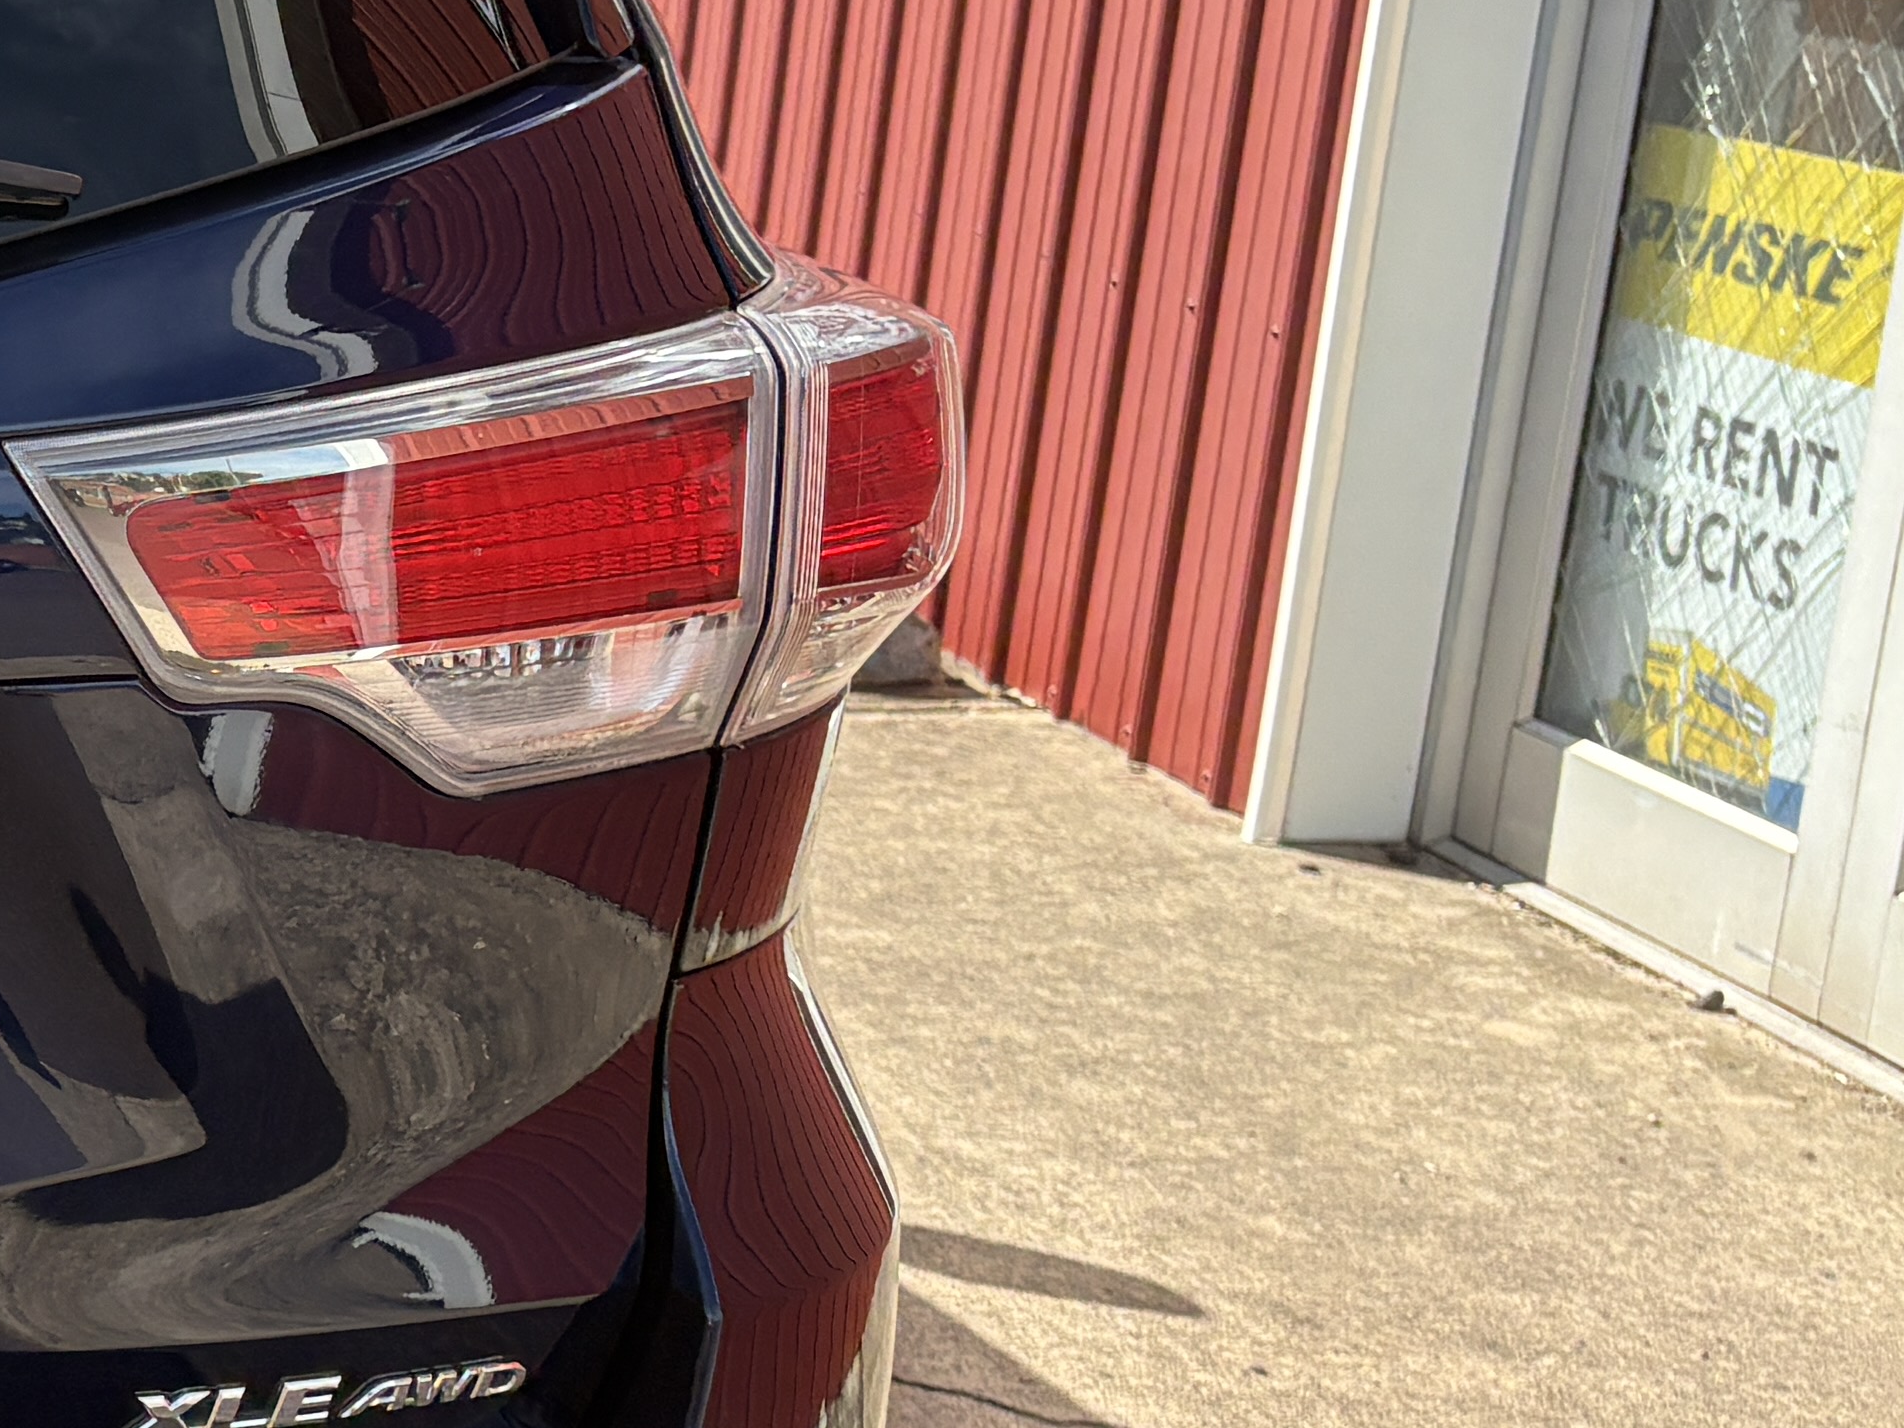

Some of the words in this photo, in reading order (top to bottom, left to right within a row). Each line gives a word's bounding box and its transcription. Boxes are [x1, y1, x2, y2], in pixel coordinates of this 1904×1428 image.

[1623, 197, 1866, 307] PENSKE
[1687, 405, 1840, 518] RENT
[1597, 473, 1804, 612] TRUCKS
[337, 1357, 527, 1419] AWD
